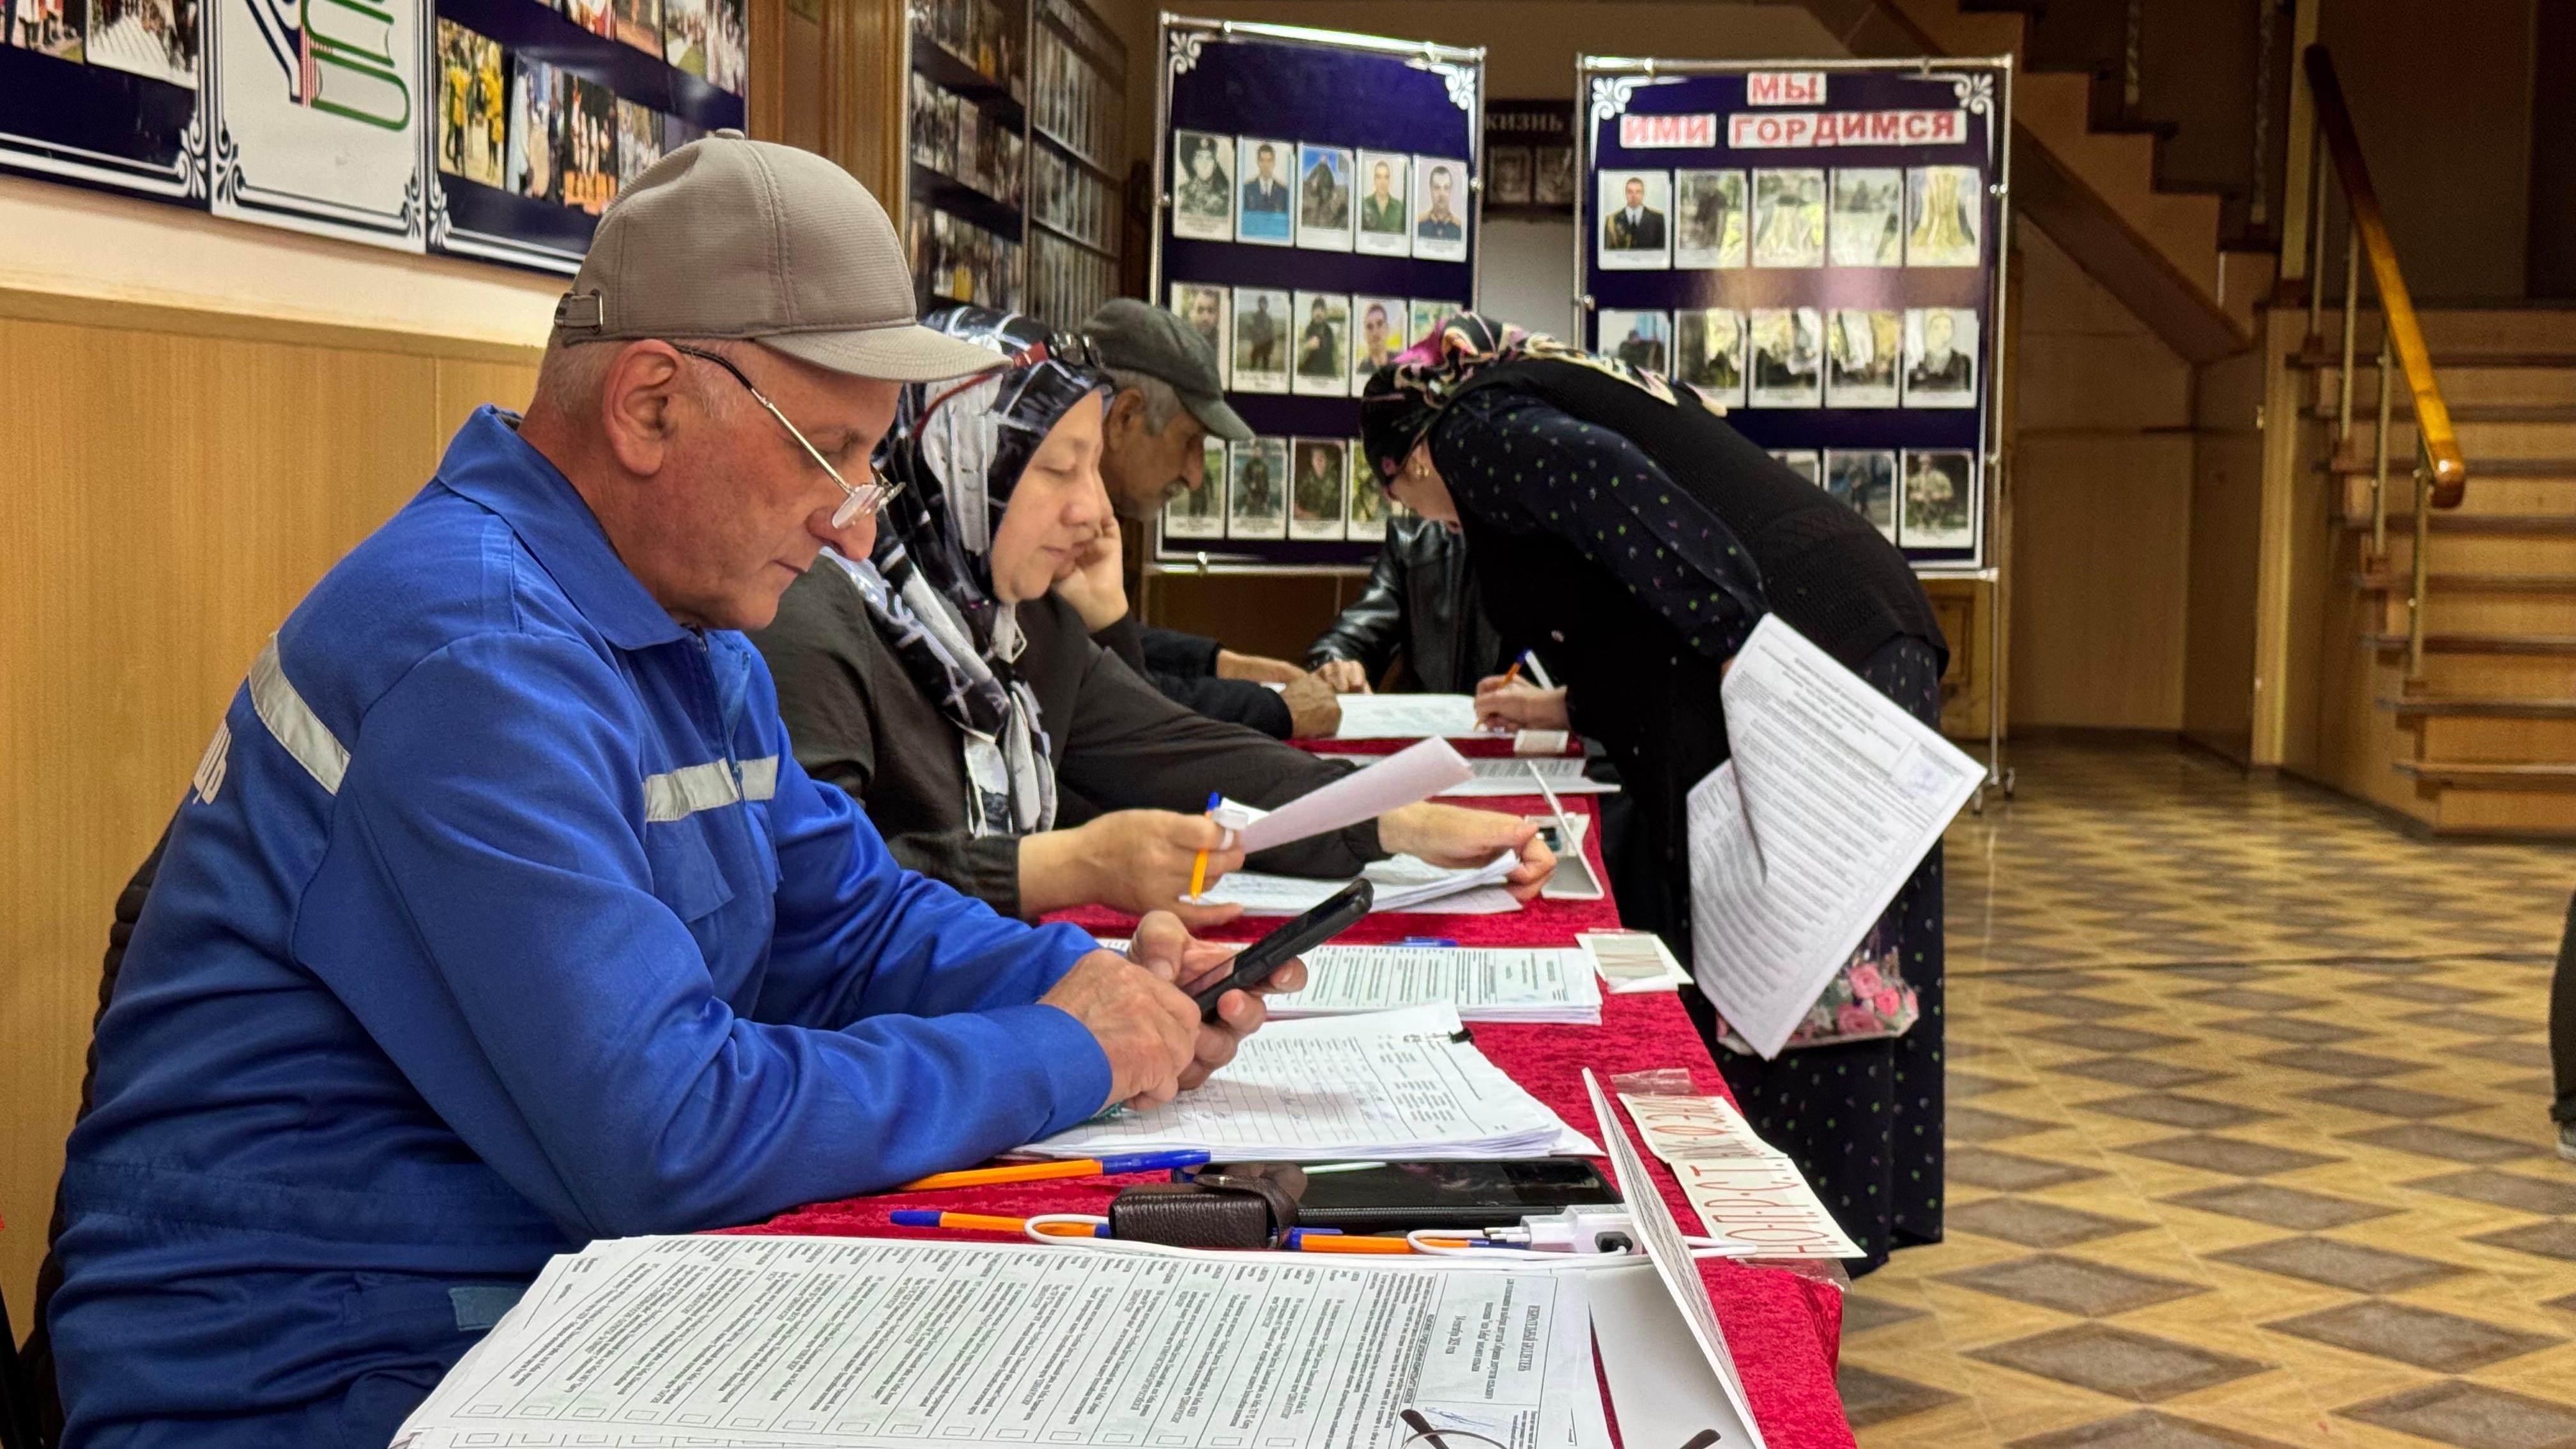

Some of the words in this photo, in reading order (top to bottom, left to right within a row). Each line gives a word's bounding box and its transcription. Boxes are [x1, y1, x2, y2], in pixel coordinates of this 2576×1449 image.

[1751, 75, 1818, 100] МЫ
[1624, 115, 1708, 142] ИМИ
[1732, 111, 1956, 146] ГОРДИМСЯ
